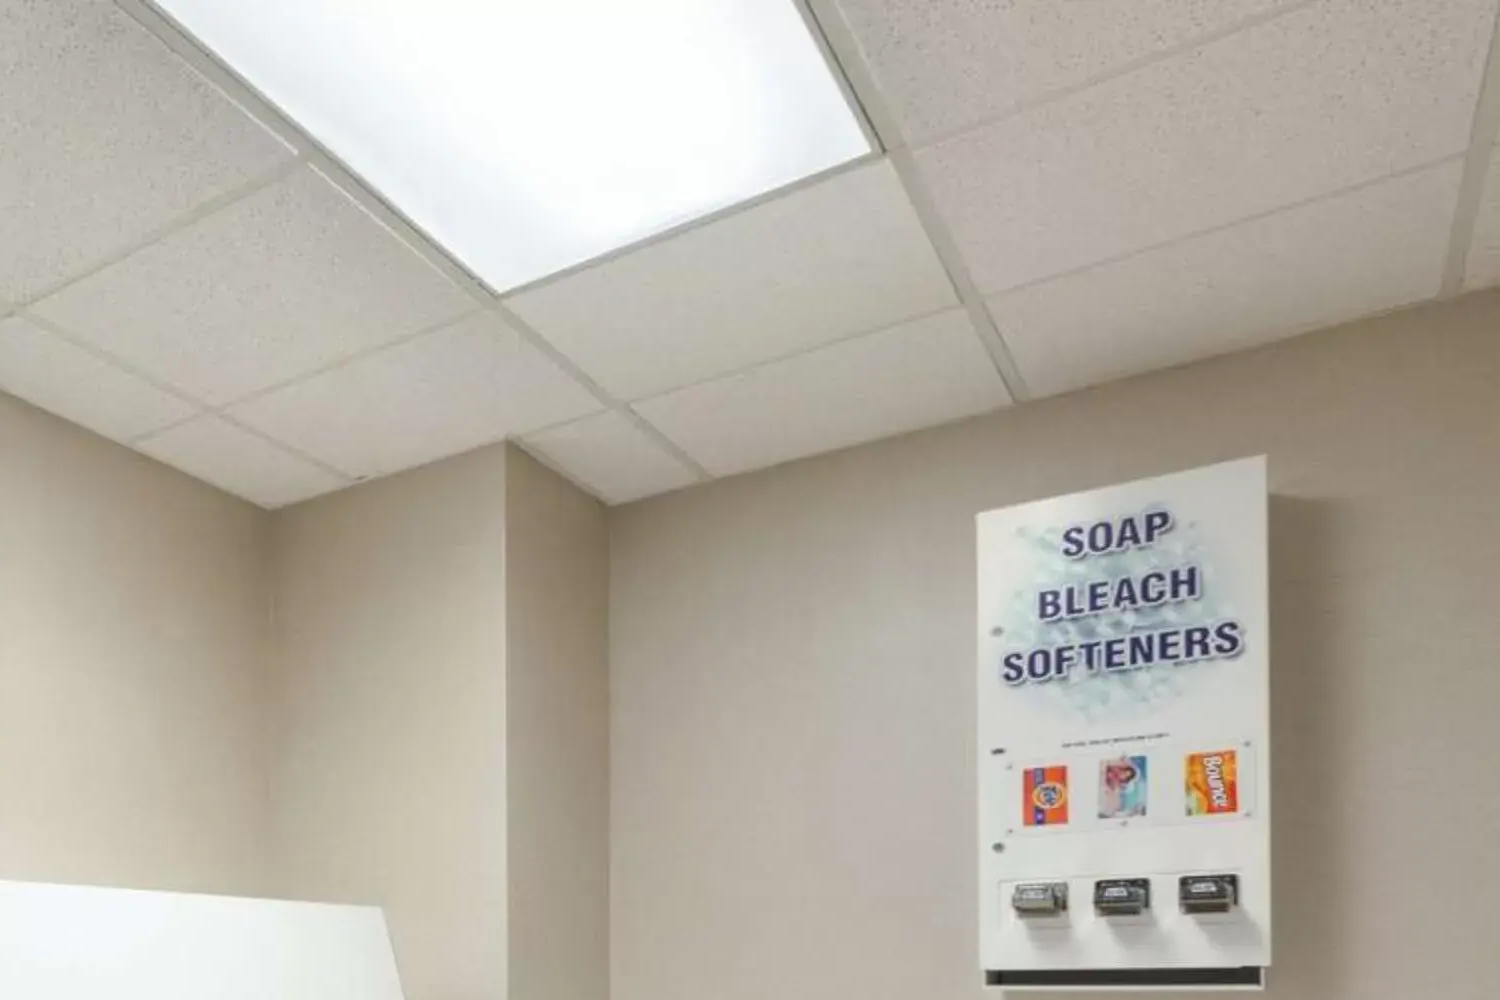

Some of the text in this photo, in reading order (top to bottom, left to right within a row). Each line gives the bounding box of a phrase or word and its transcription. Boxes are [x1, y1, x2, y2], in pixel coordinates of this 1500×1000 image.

[1061, 510, 1172, 558] SOAP
[1037, 565, 1199, 619] BLEACH
[1001, 620, 1242, 683] SOFTENERS
